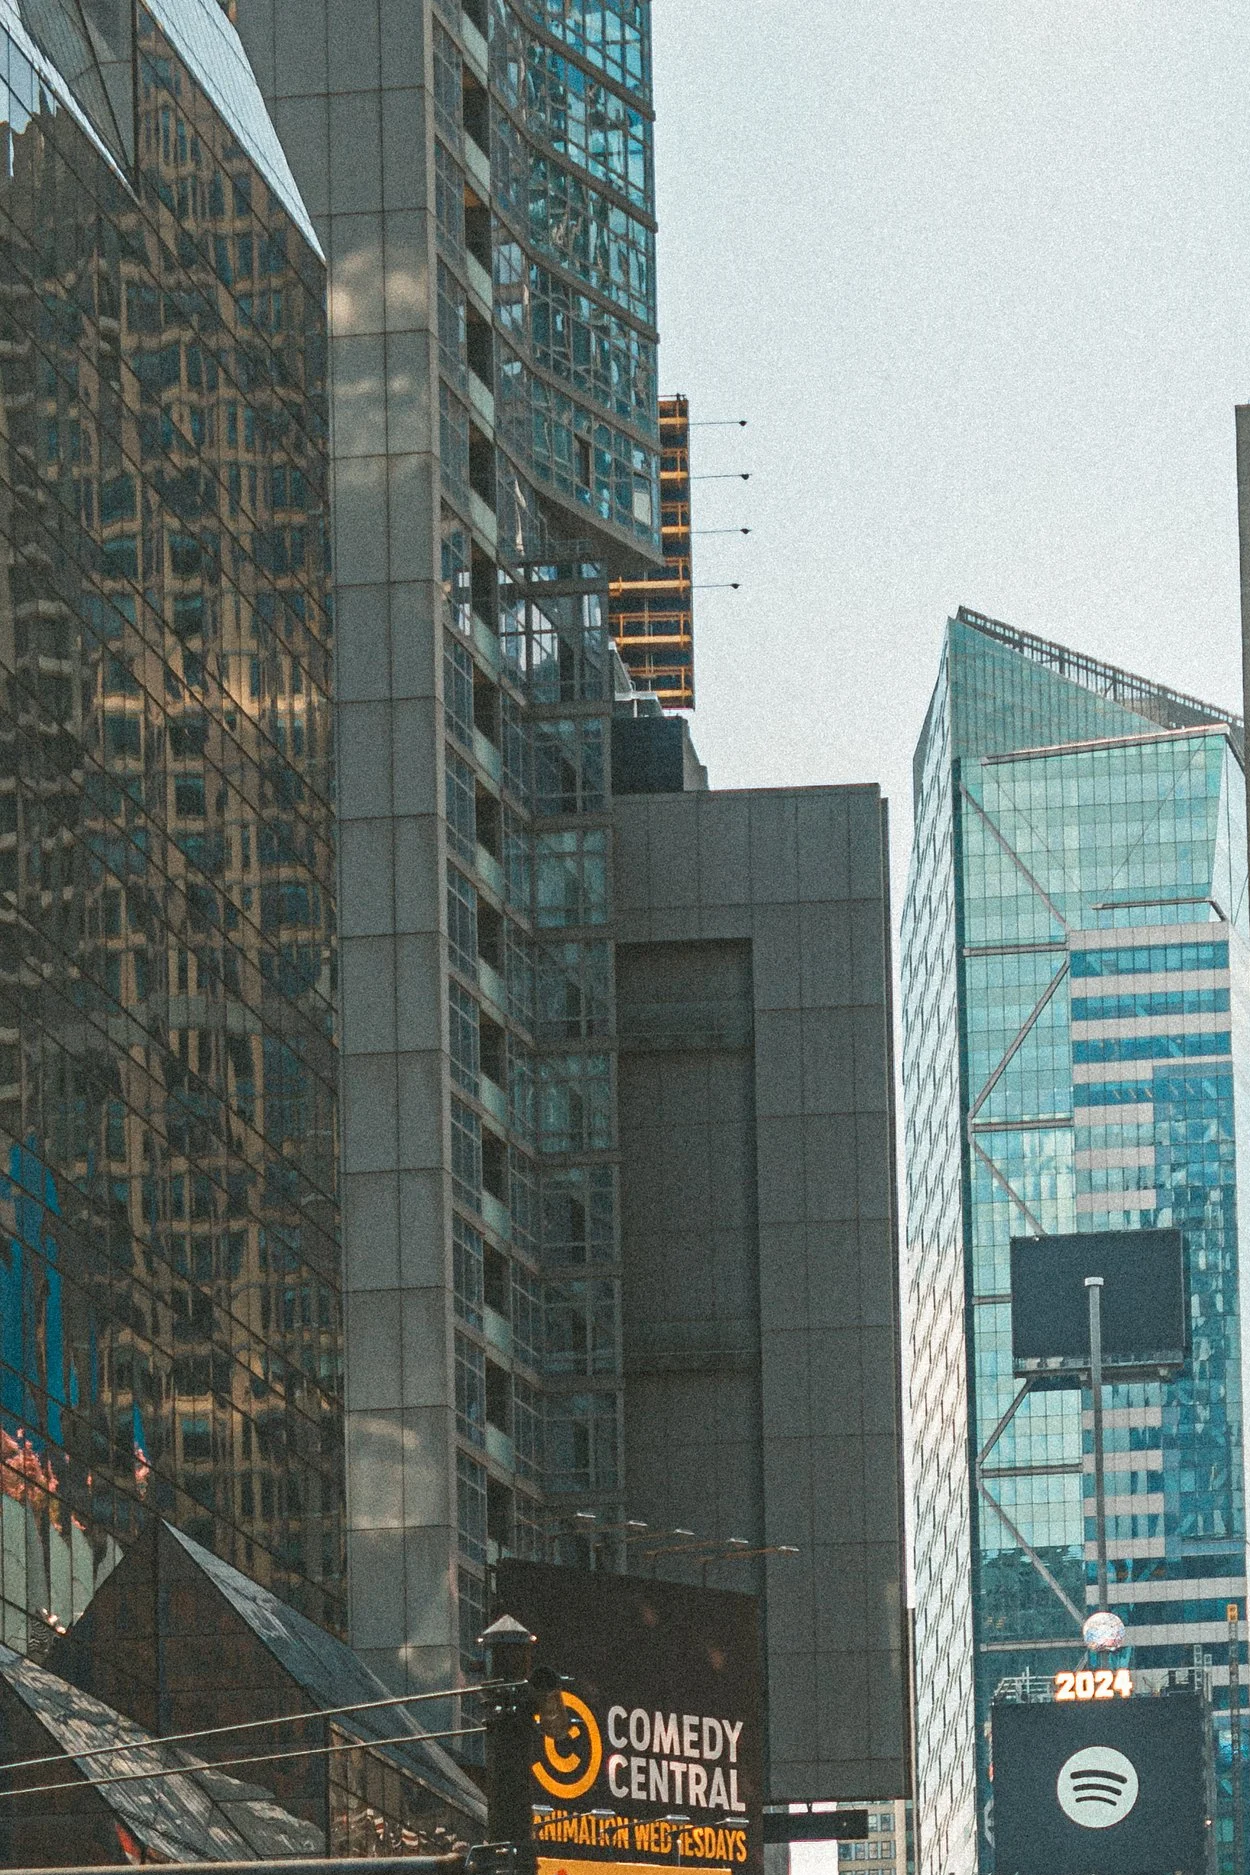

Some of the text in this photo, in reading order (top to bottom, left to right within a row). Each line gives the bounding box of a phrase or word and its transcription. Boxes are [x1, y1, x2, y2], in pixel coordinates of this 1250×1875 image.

[1054, 1669, 1133, 1702] 2024
[607, 1704, 744, 1763] COMEDY
[608, 1754, 746, 1813] CENTRAL
